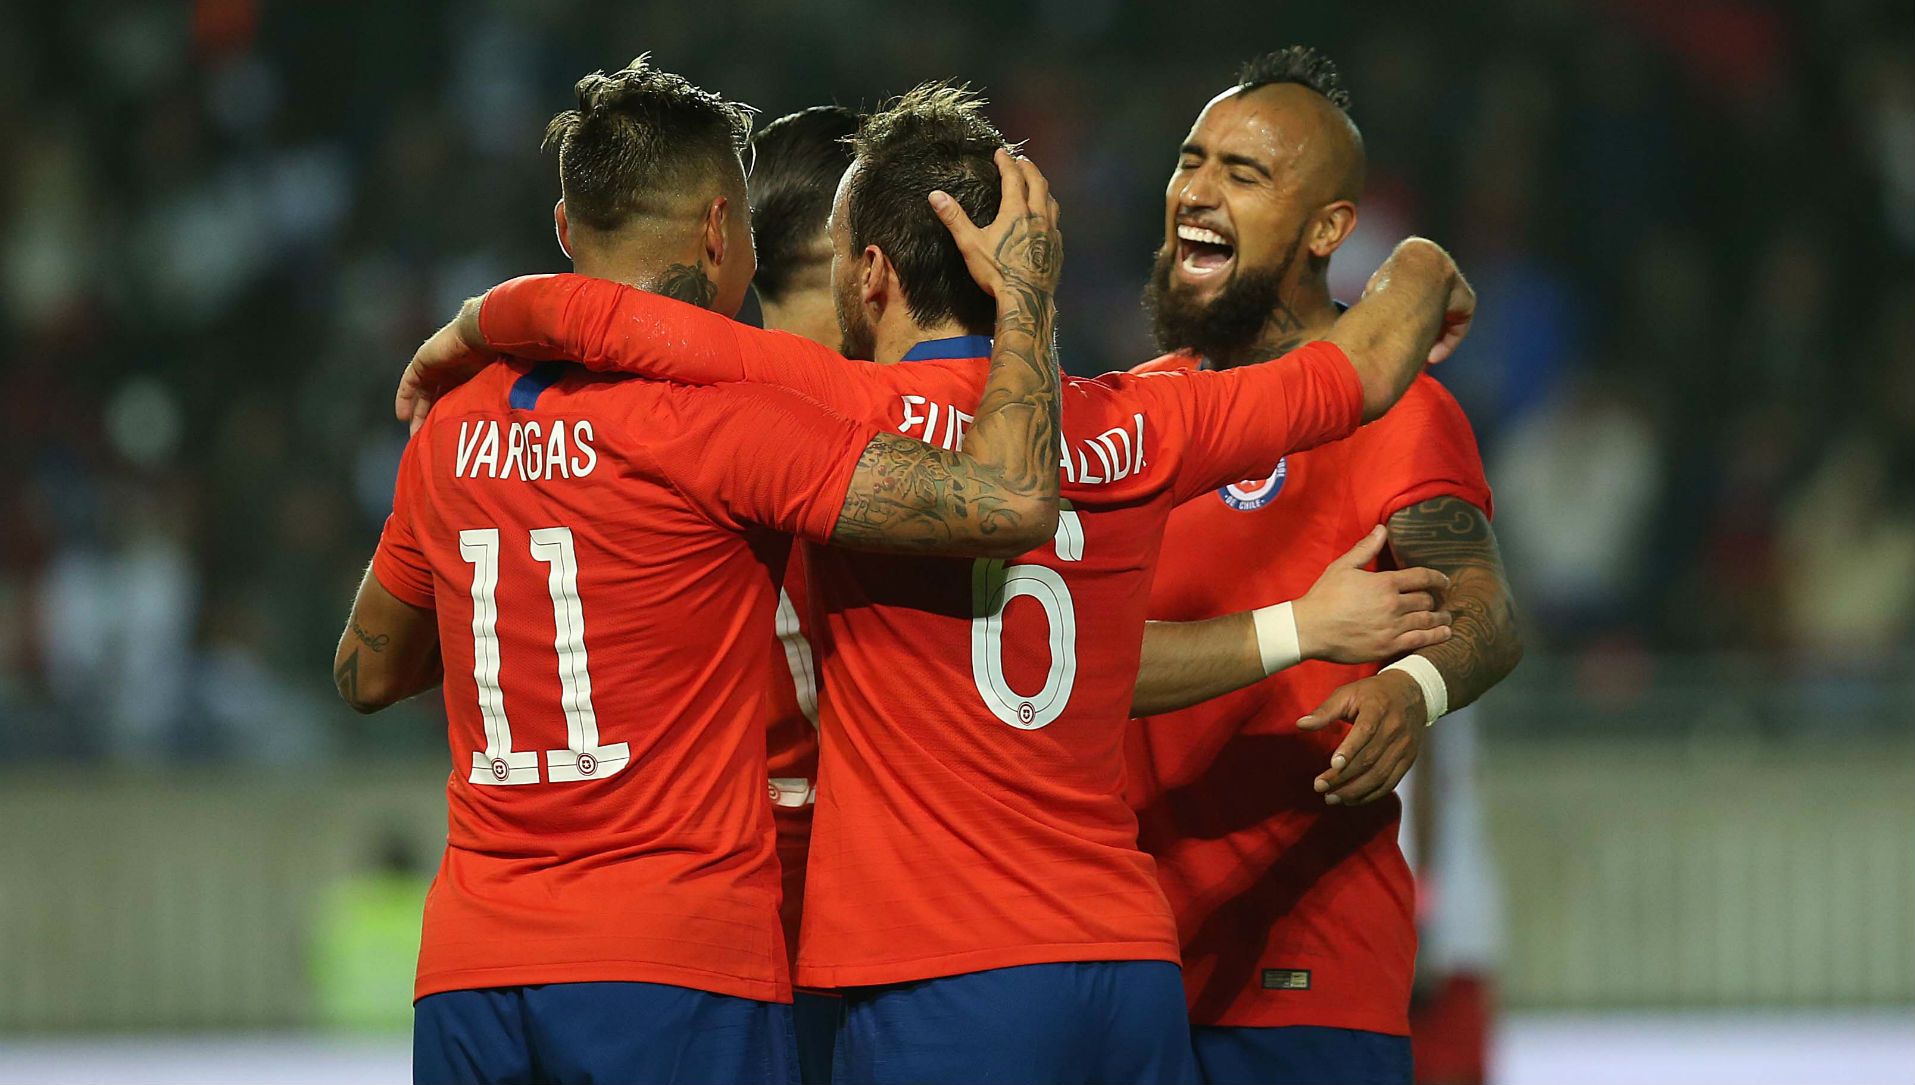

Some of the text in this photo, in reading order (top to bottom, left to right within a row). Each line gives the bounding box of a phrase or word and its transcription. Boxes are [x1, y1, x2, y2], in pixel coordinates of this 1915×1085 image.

[455, 420, 597, 481] VARGAS
[1239, 499, 1261, 510] CHILE
[458, 526, 630, 785] 11
[971, 498, 1086, 731] 6
